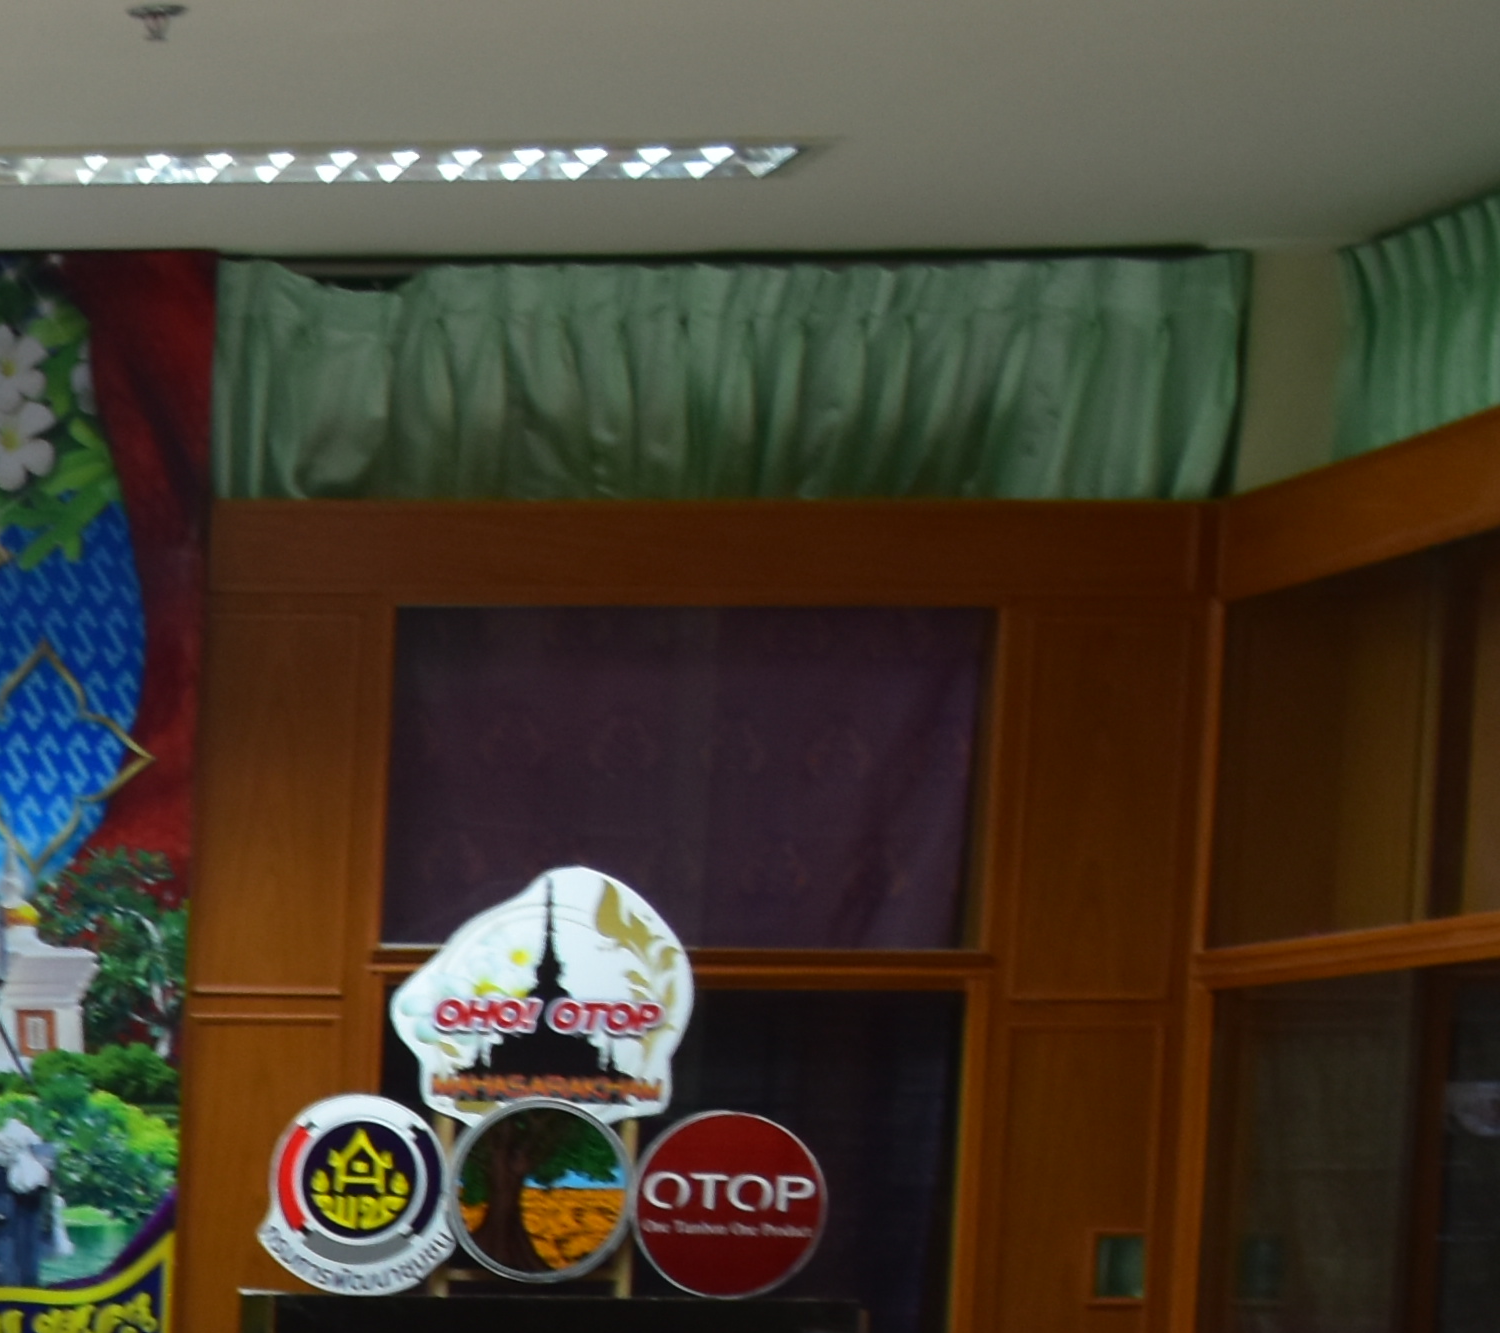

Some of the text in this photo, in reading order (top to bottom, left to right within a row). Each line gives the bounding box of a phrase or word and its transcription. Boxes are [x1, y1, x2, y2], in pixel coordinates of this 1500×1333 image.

[435, 997, 665, 1037] OHO! OTOP
[642, 1170, 817, 1213] OTOP
